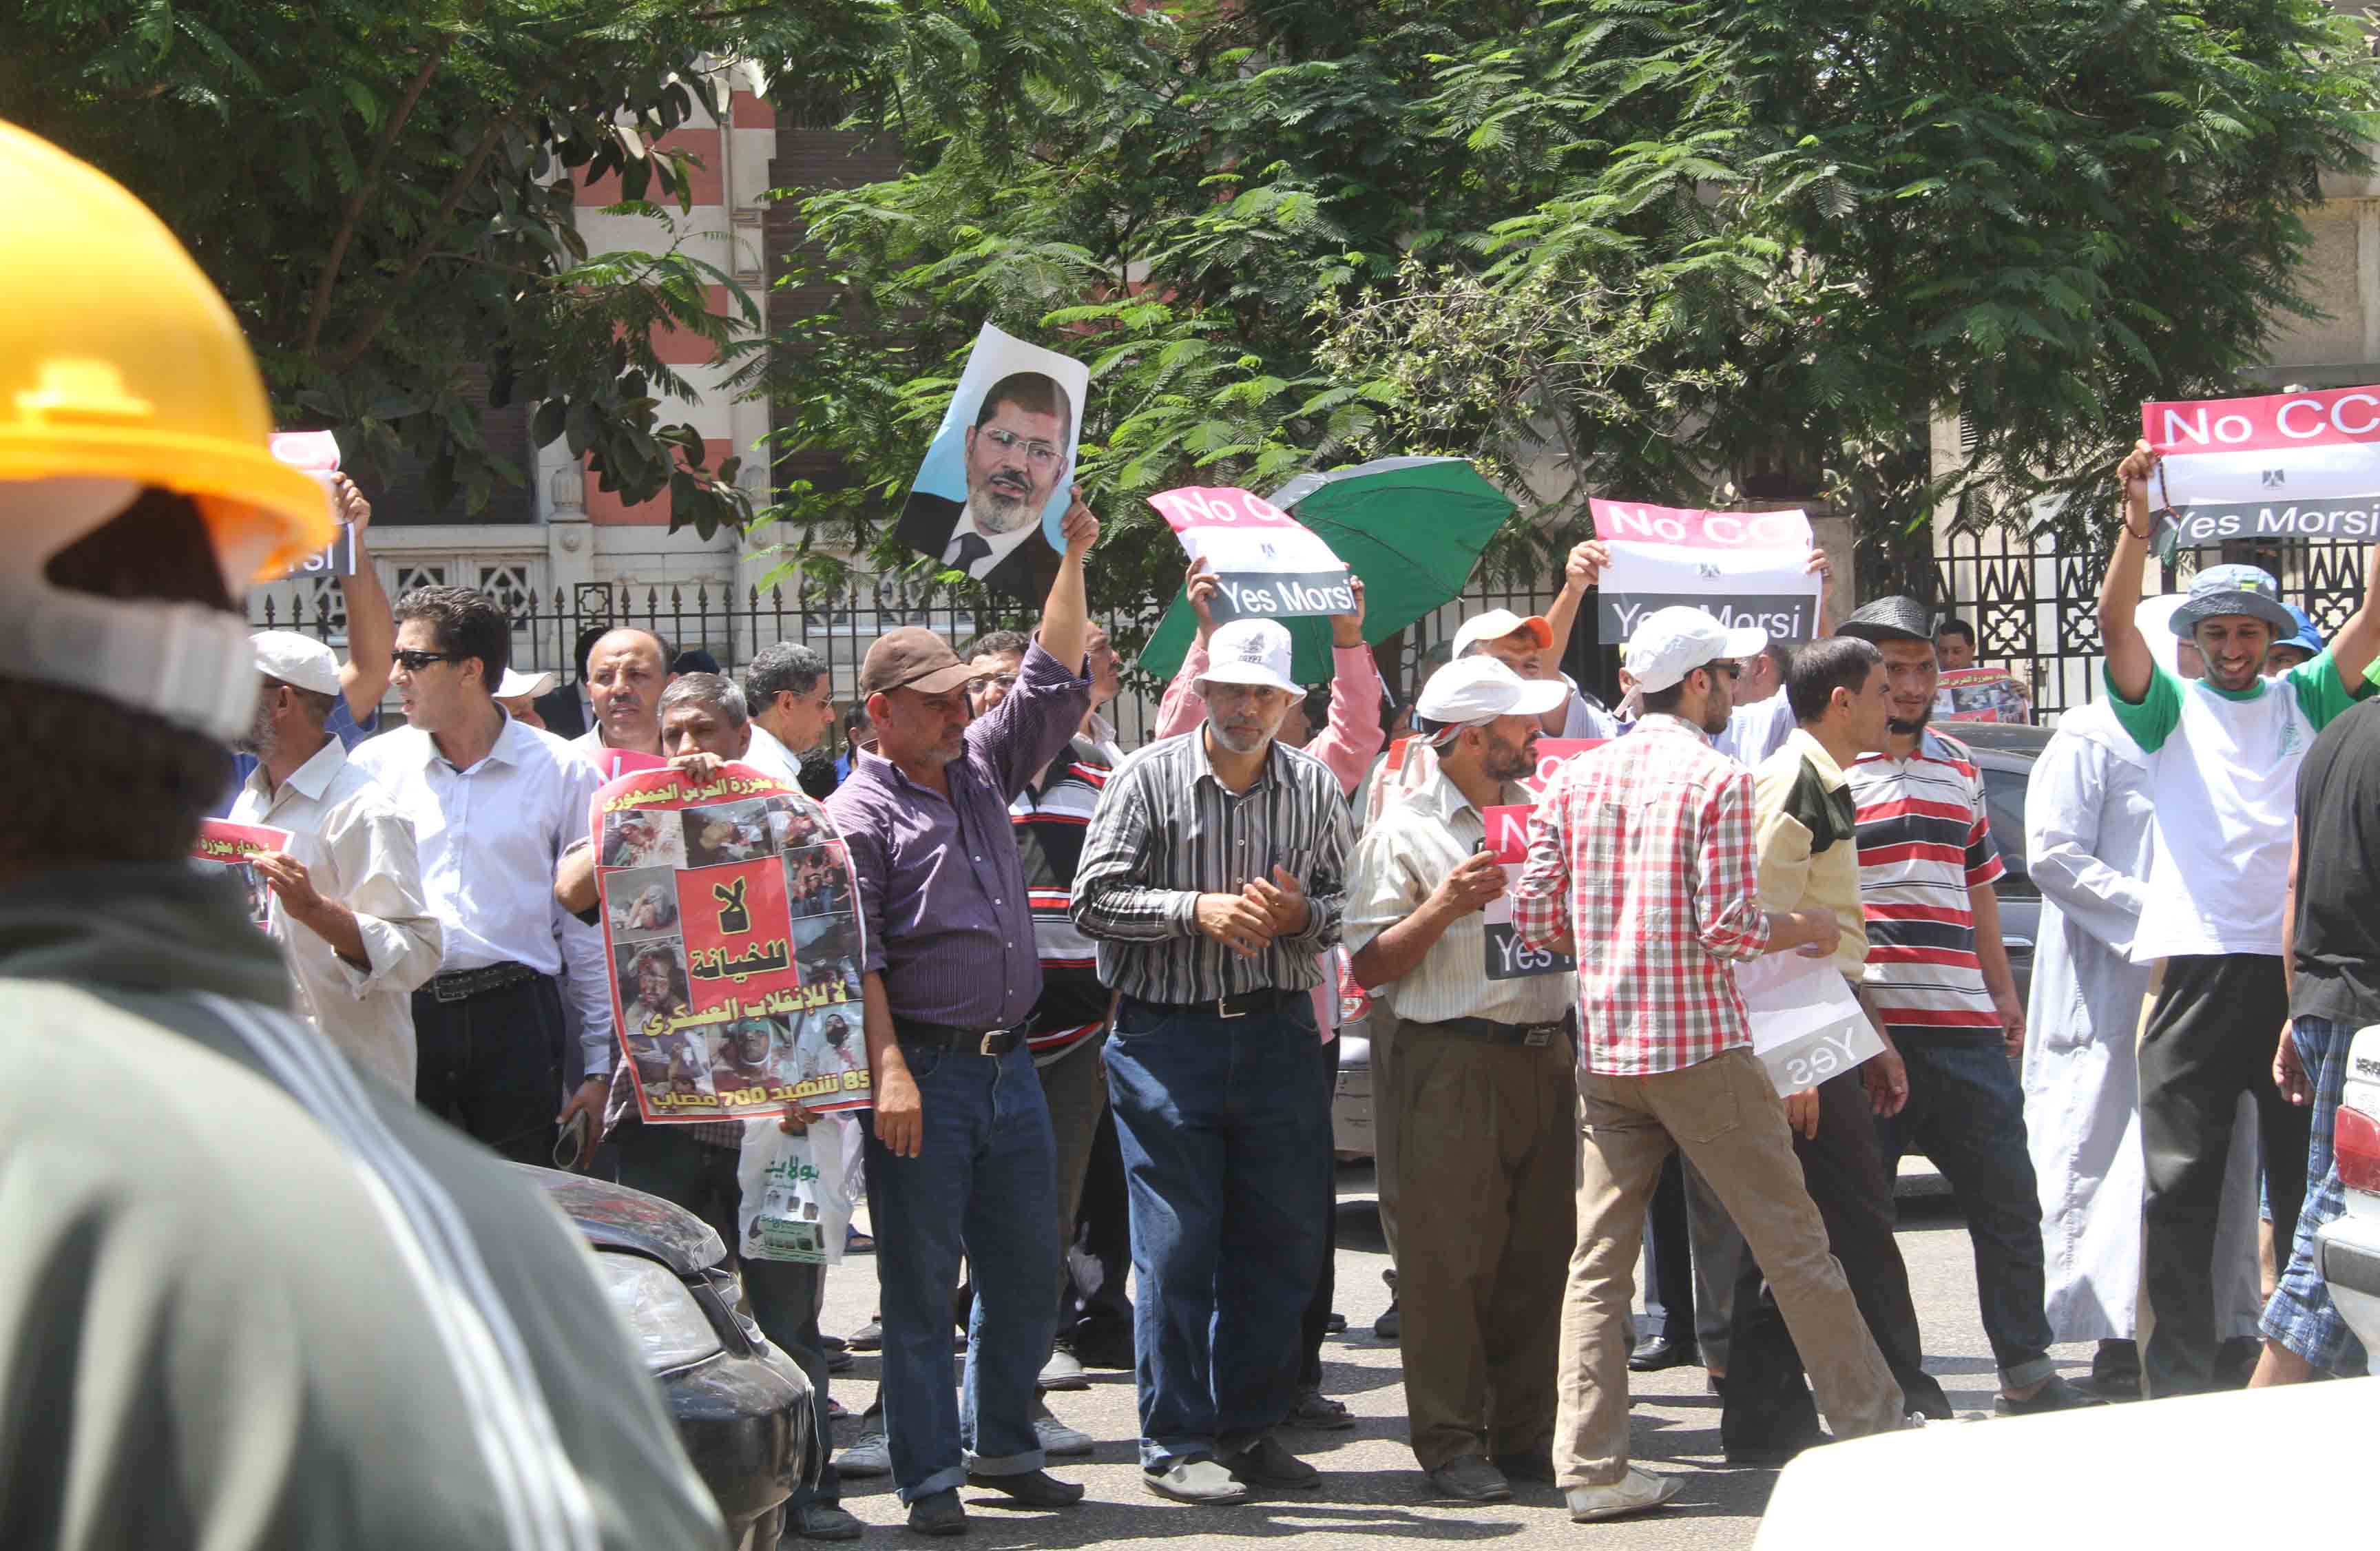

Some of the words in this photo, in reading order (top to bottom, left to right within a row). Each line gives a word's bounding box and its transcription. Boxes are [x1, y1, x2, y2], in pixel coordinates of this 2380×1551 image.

[2163, 408, 2253, 447] No
[2276, 393, 2380, 439] CC
[1168, 492, 1236, 522] No
[1608, 505, 1686, 541] No
[2164, 511, 2241, 543] Yes
[2256, 503, 2380, 537] Morsi
[1217, 582, 1277, 613] Yes
[1276, 579, 1357, 612] Morsi
[682, 778, 728, 802] الحرس
[731, 776, 773, 794] مجزرة
[713, 876, 751, 935] لا
[690, 937, 790, 983] للخيانة
[1495, 934, 1552, 972] Yes
[831, 979, 848, 1003] لا
[771, 1072, 839, 1103] شهيد
[843, 1068, 870, 1090] 85
[651, 1090, 718, 1110] مصاب
[718, 1086, 767, 1107] 700
